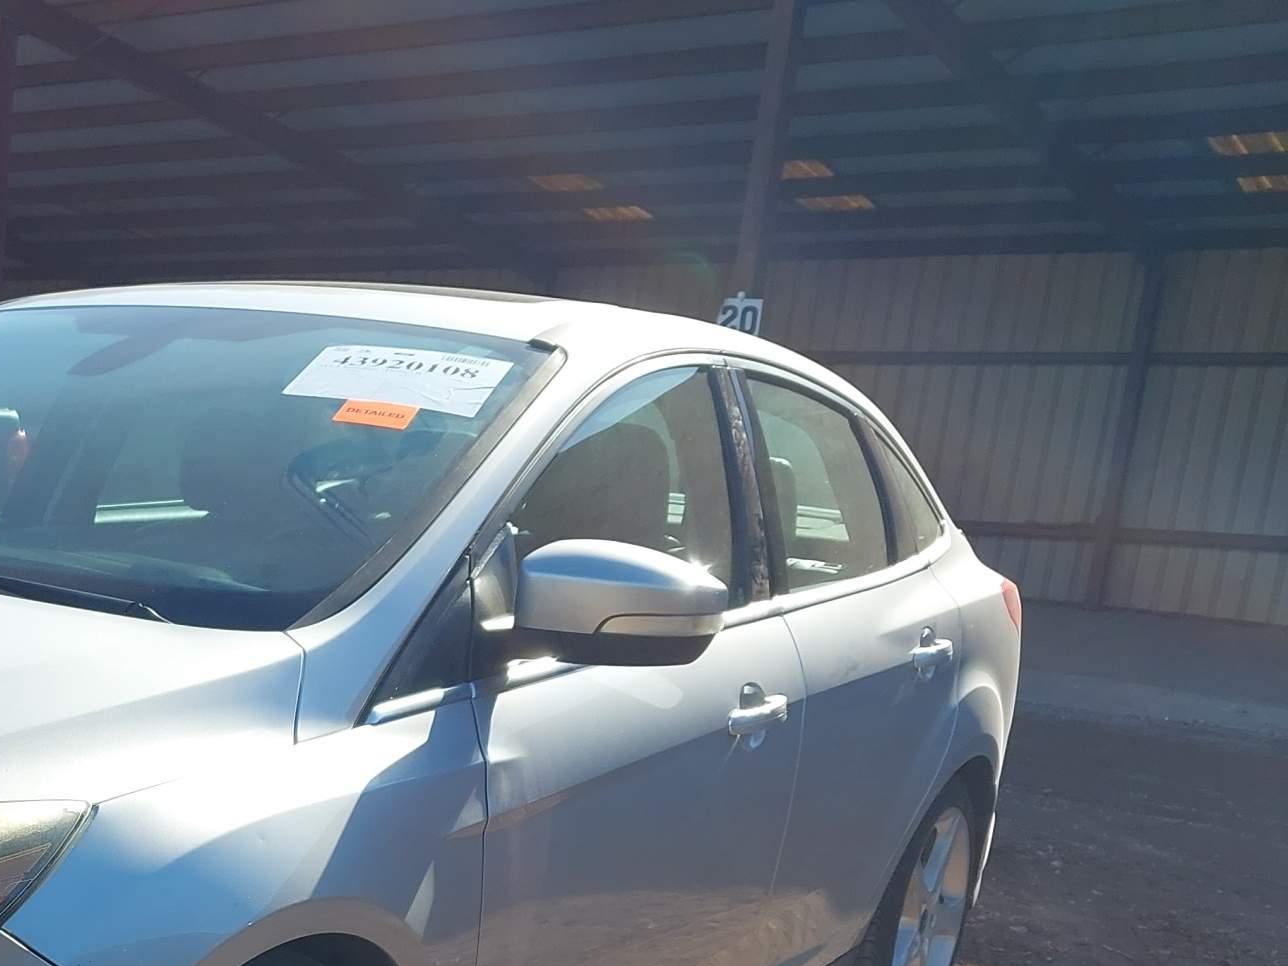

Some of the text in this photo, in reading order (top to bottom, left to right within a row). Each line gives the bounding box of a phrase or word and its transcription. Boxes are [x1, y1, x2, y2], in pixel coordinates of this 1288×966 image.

[720, 305, 758, 334] 20
[333, 355, 480, 379] 43920108
[345, 407, 405, 419] DETAILED
